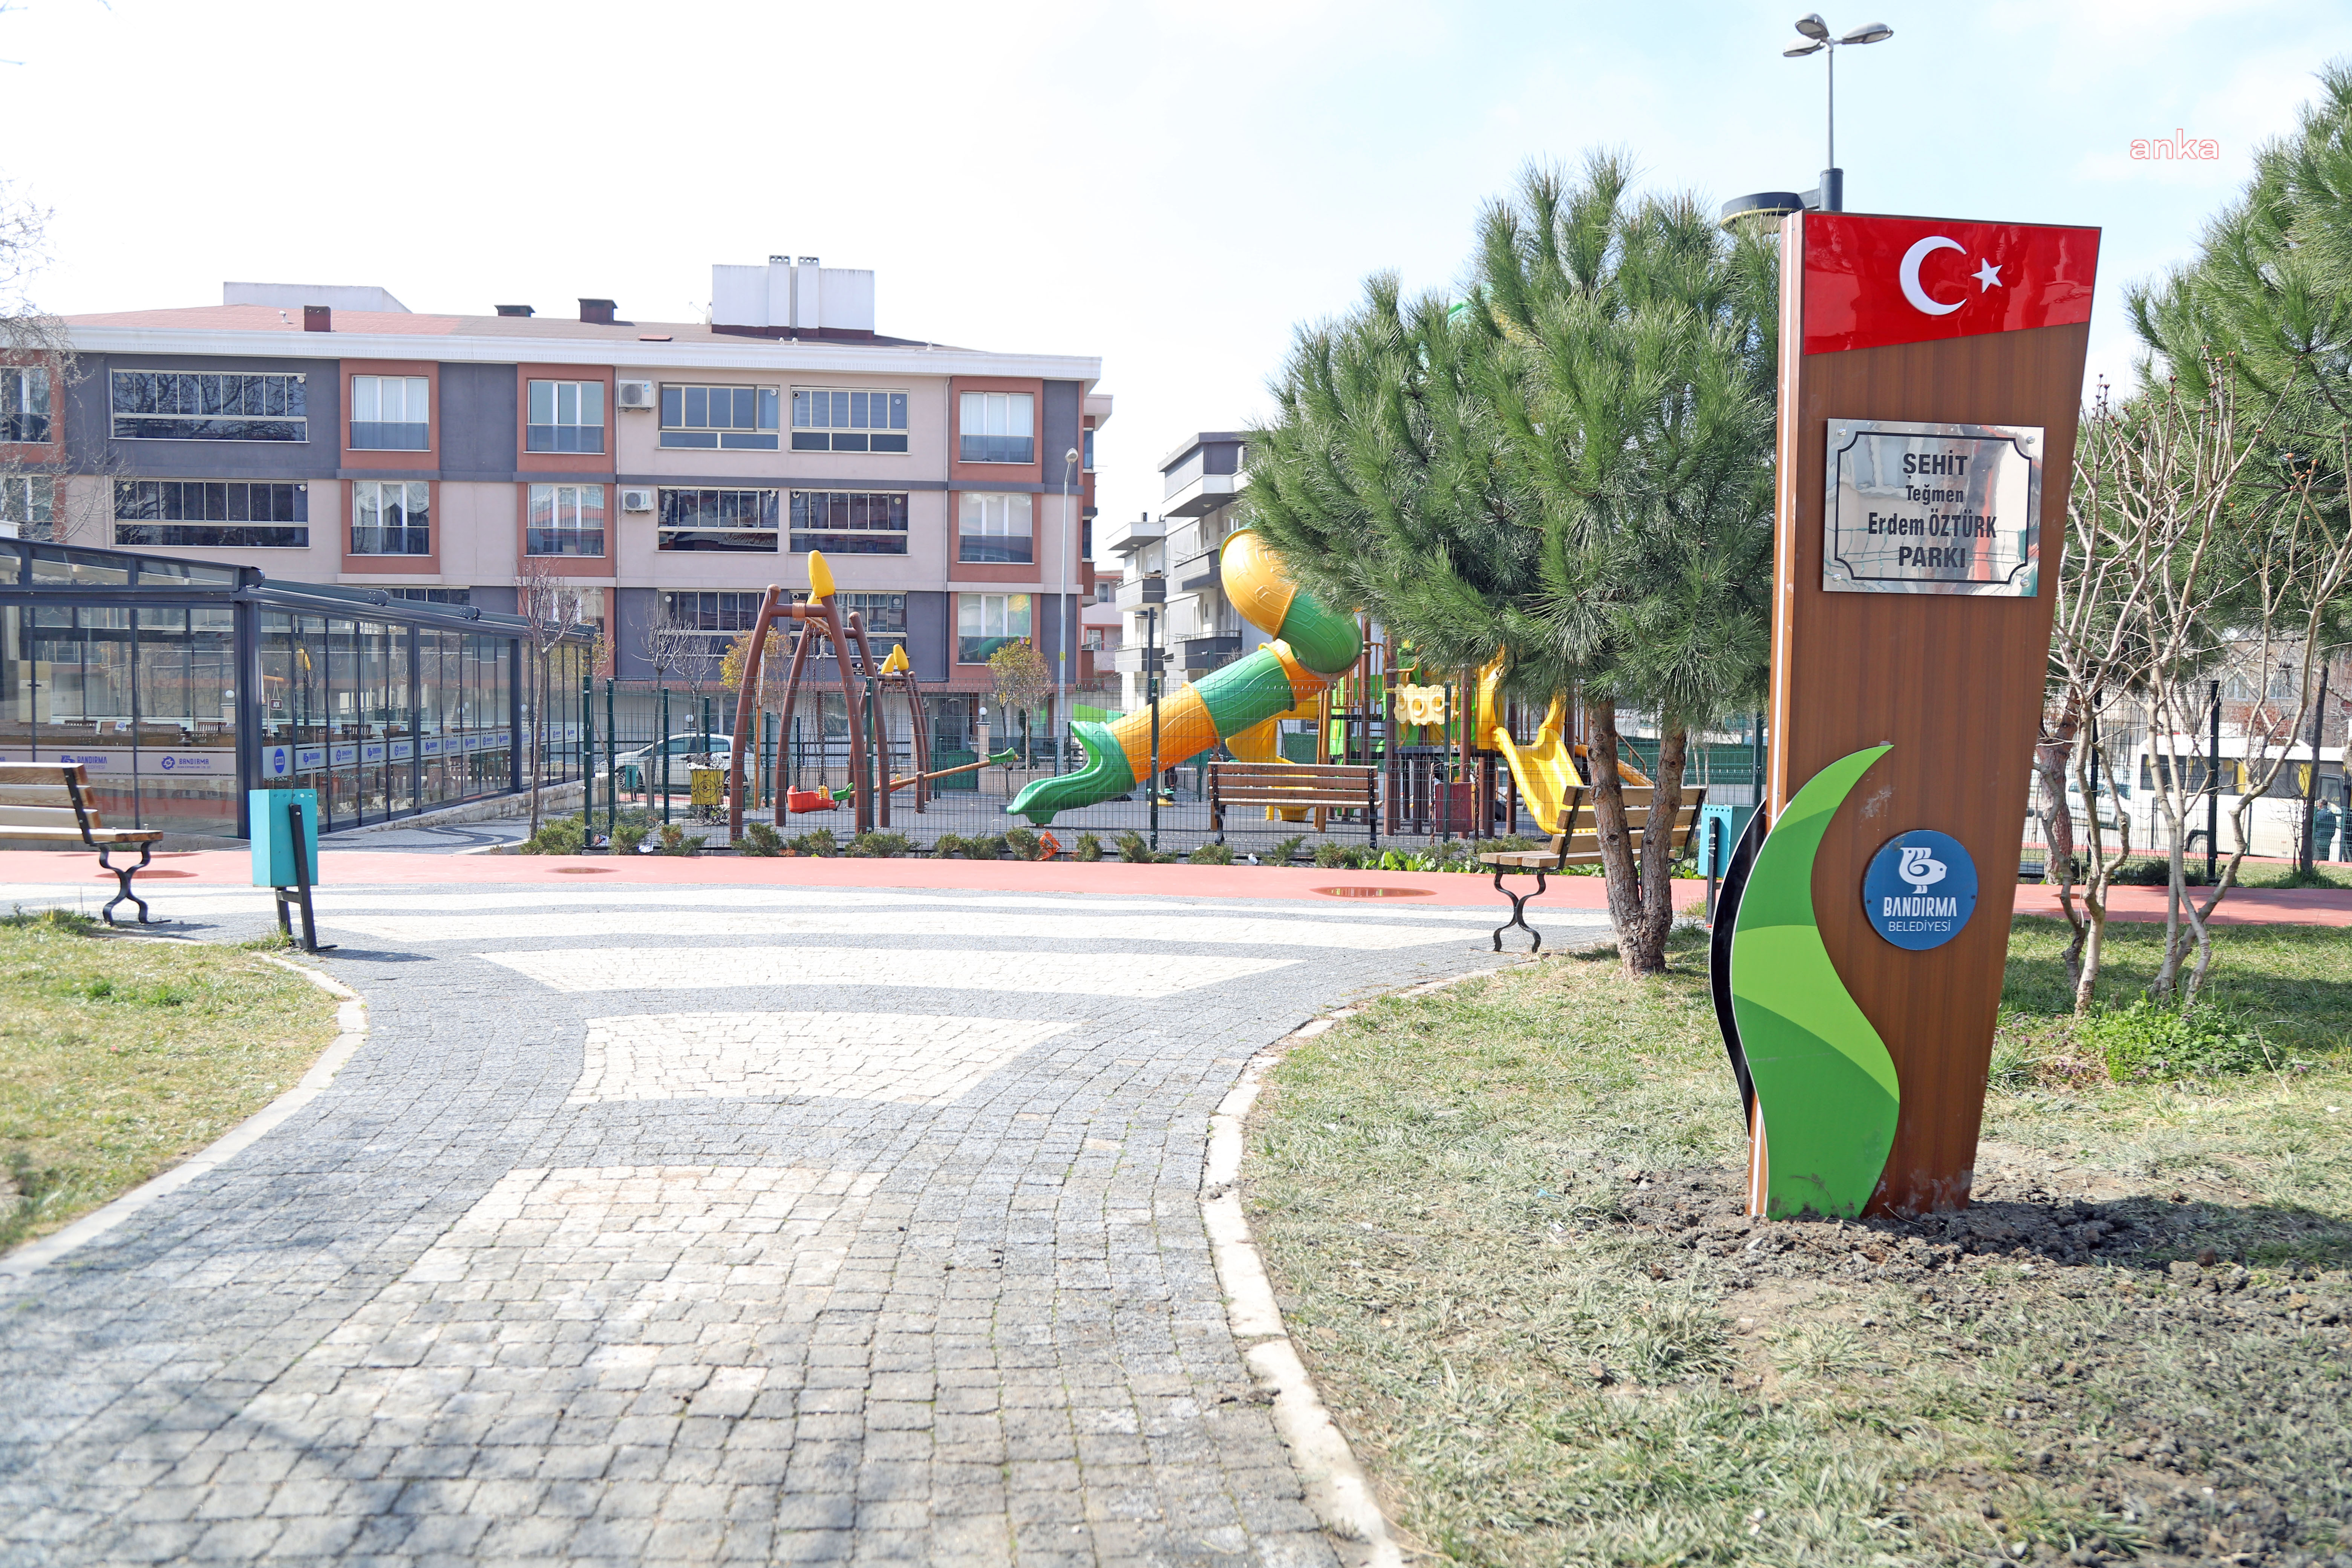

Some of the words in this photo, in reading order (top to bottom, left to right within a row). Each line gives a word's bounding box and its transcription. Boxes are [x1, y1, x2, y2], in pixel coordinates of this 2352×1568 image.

[1903, 450, 1968, 479] ŞEHİT
[1906, 484, 1964, 505] Teğmen
[1868, 512, 1924, 535] Erdem
[1929, 508, 1997, 538] ÖZTÜRK
[1899, 546, 1966, 568] PARKI
[1883, 897, 1957, 917] BANDIRMA
[1888, 920, 1951, 931] BELEDİYESİ
